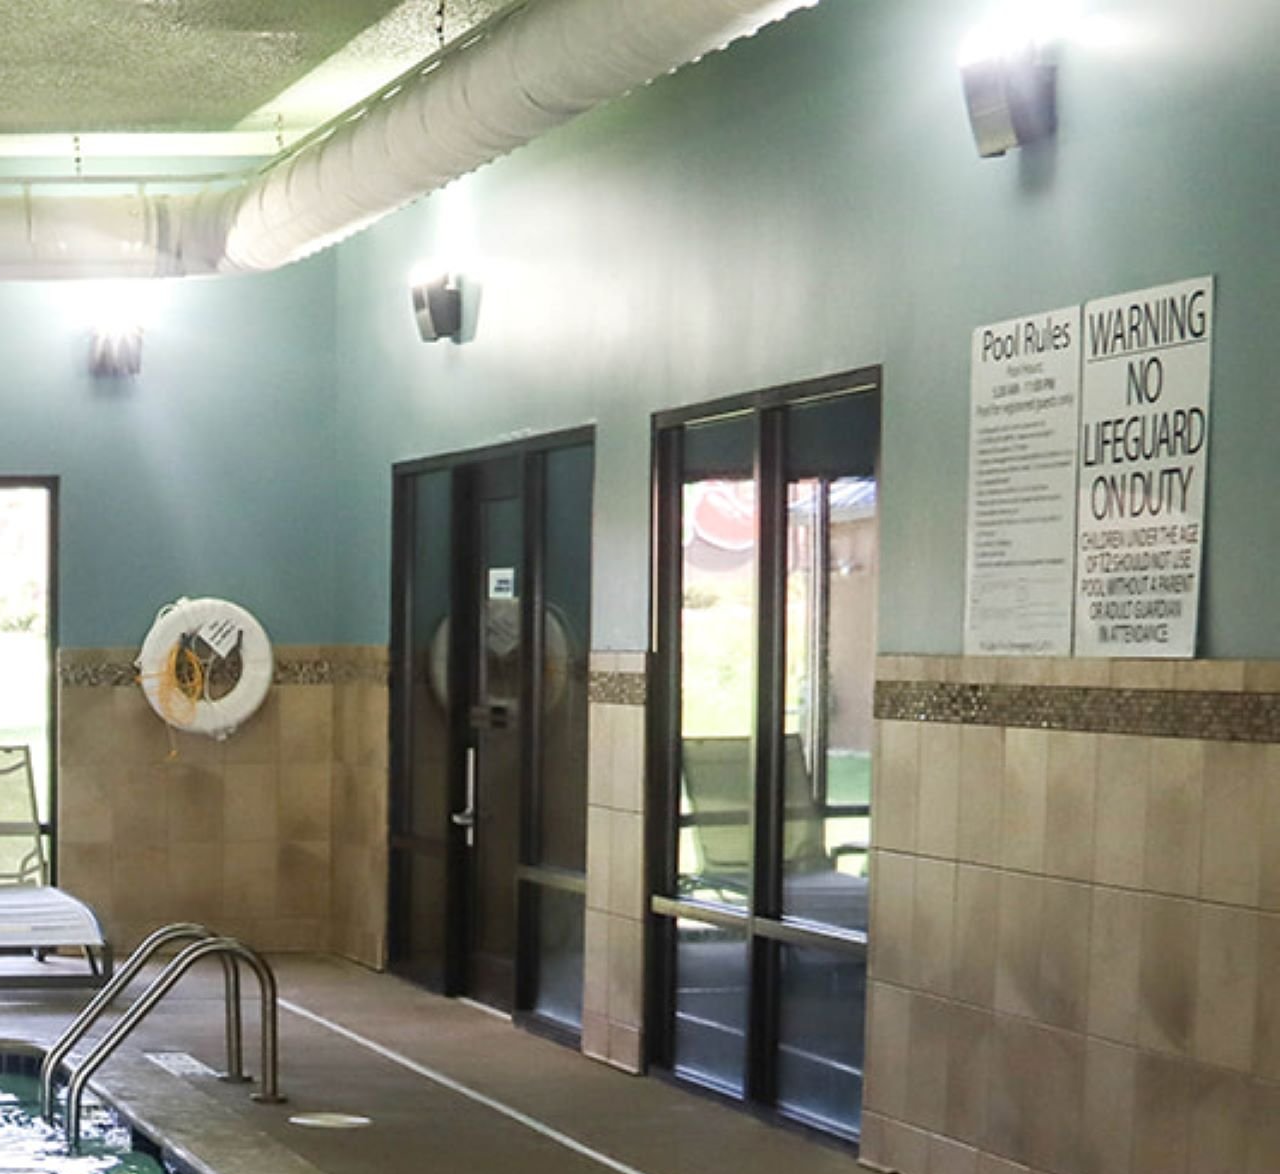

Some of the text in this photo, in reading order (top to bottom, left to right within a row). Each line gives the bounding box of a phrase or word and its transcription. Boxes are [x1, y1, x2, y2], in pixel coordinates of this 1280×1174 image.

[982, 317, 1071, 361] Pool Rules
[1089, 290, 1206, 356] WARNING
[1127, 357, 1162, 405] NO
[1084, 407, 1205, 467] LIFEGUARD
[1092, 466, 1193, 520] ON DUTY
